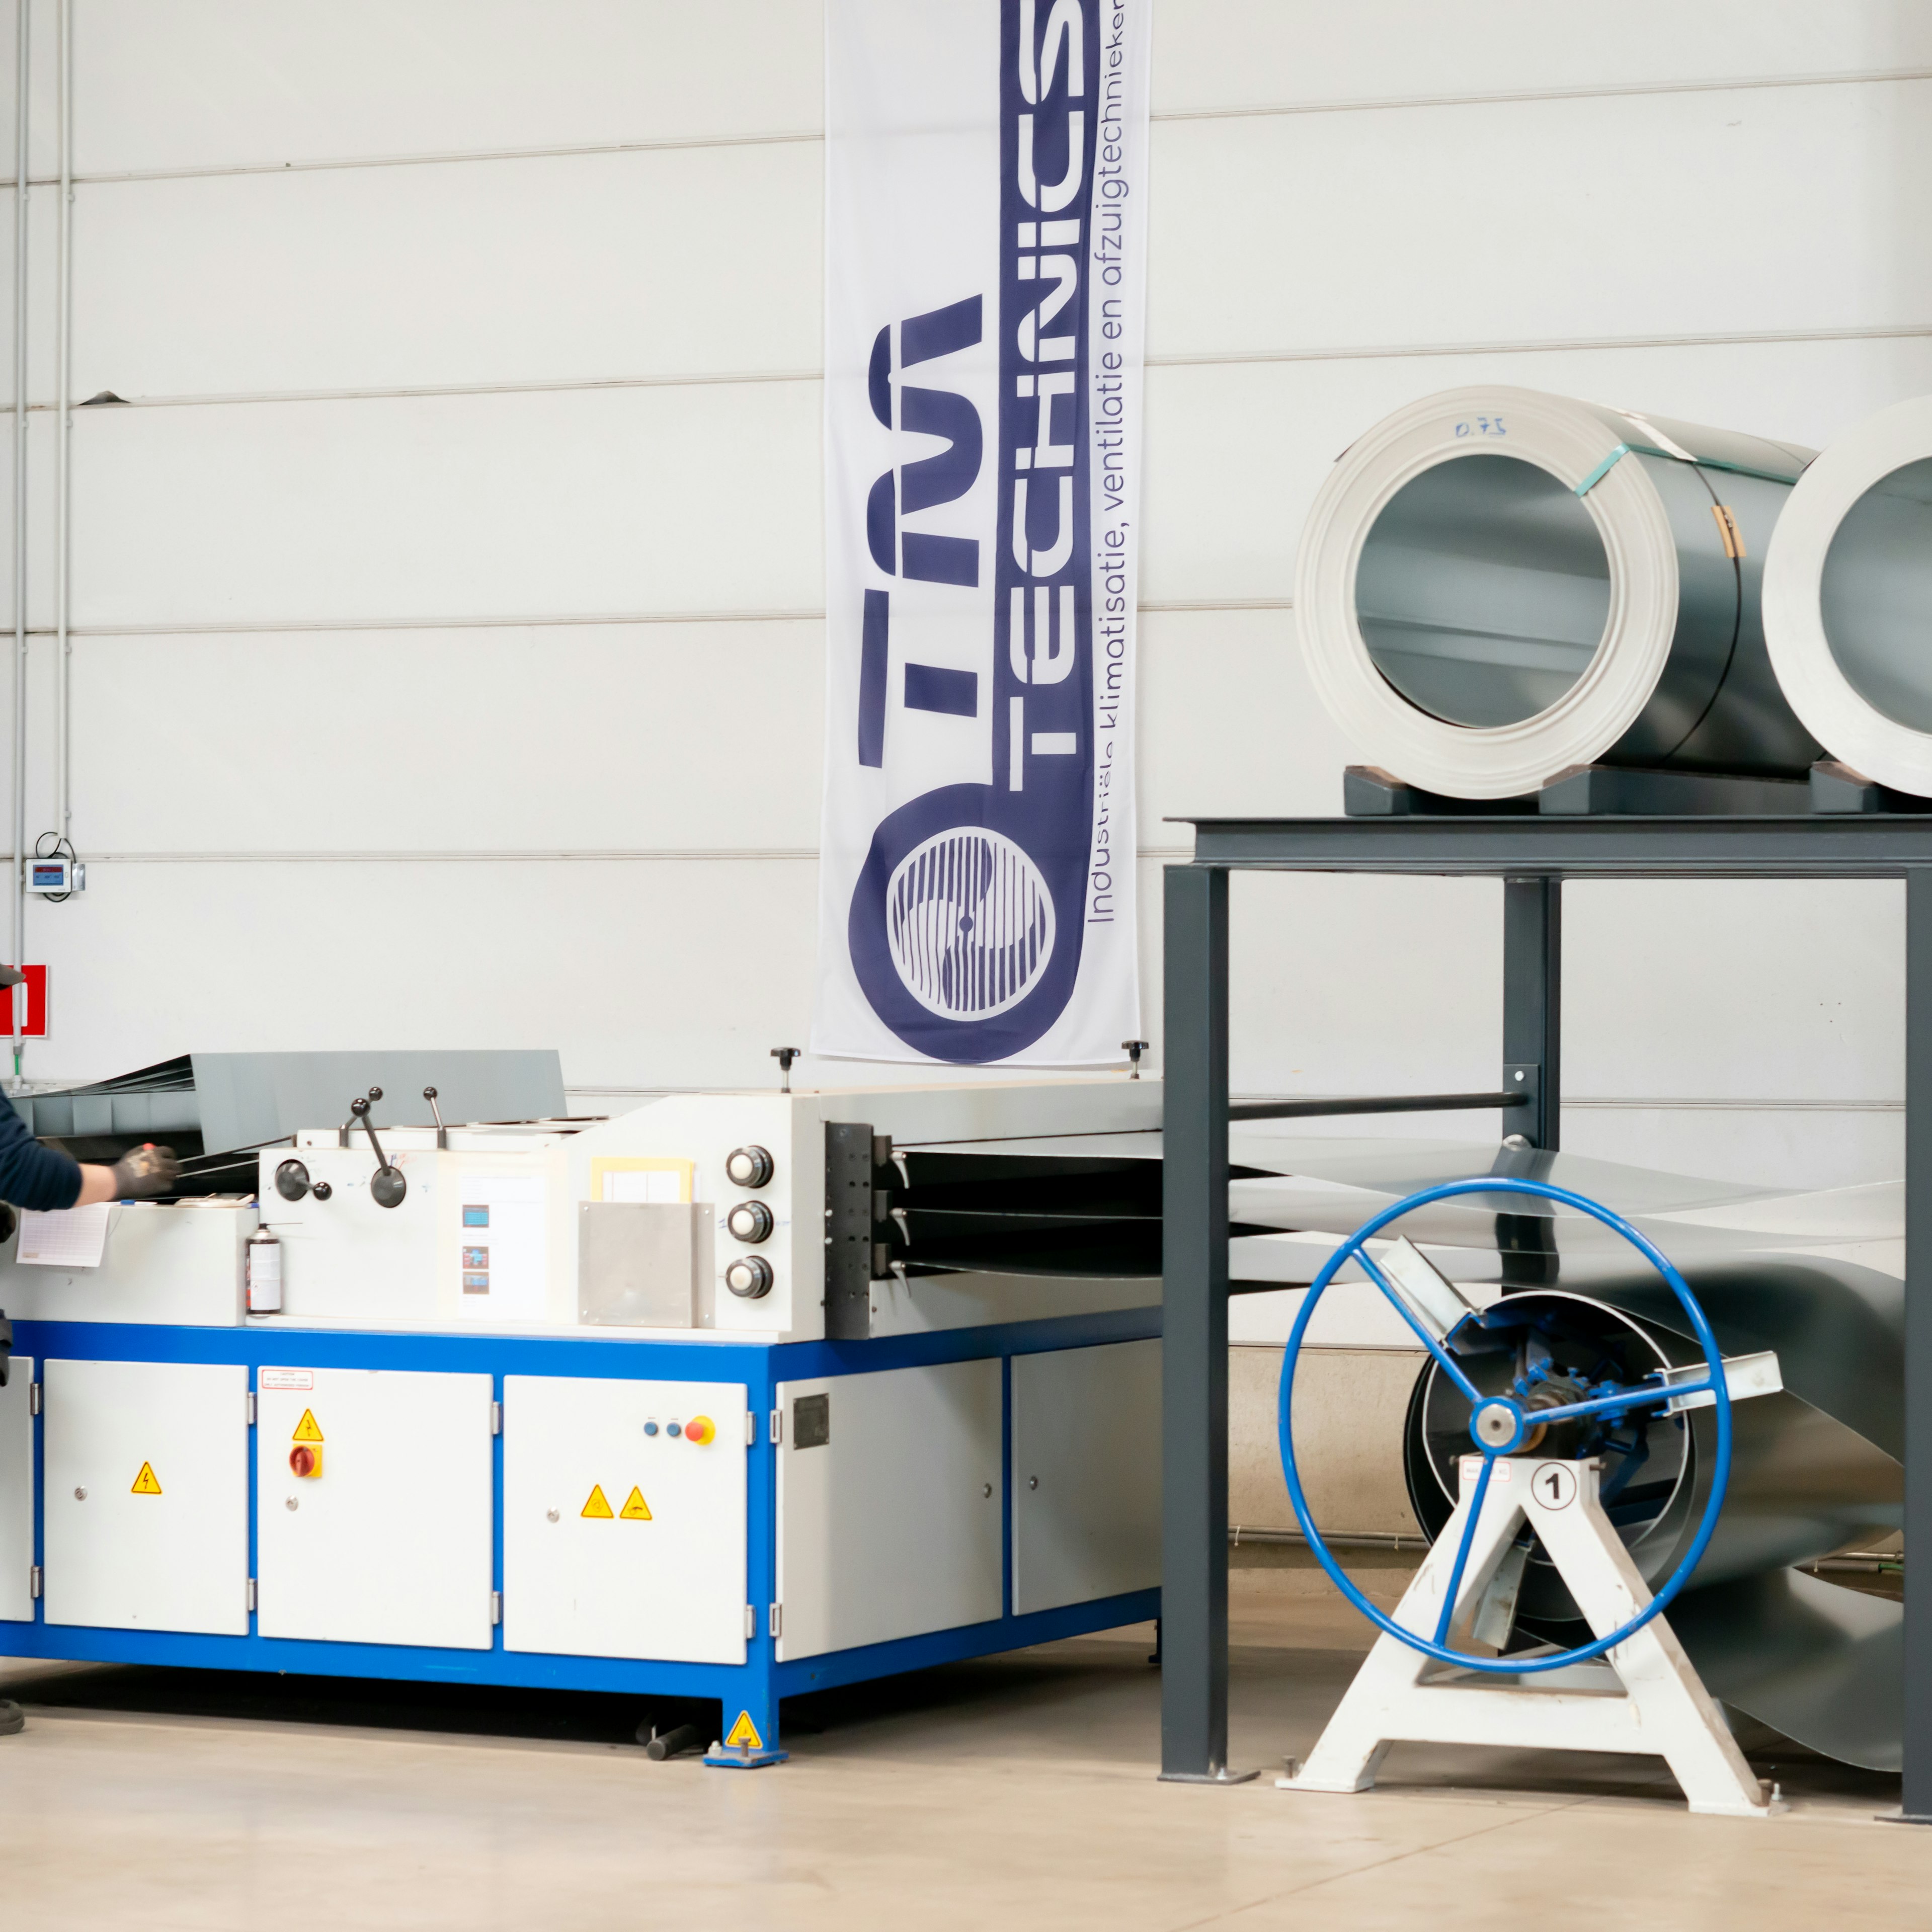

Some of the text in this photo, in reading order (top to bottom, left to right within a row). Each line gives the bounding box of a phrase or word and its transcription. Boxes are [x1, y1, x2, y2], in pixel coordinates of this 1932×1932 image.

[1009, 0, 1084, 791] TECHNICS
[1102, 299, 1122, 340] en
[1095, 352, 1124, 511] ventilatie
[1456, 417, 1506, 437] 0.75
[858, 293, 983, 769] TM
[1098, 522, 1130, 729] klimatisatie,
[1545, 1473, 1559, 1499] 1
